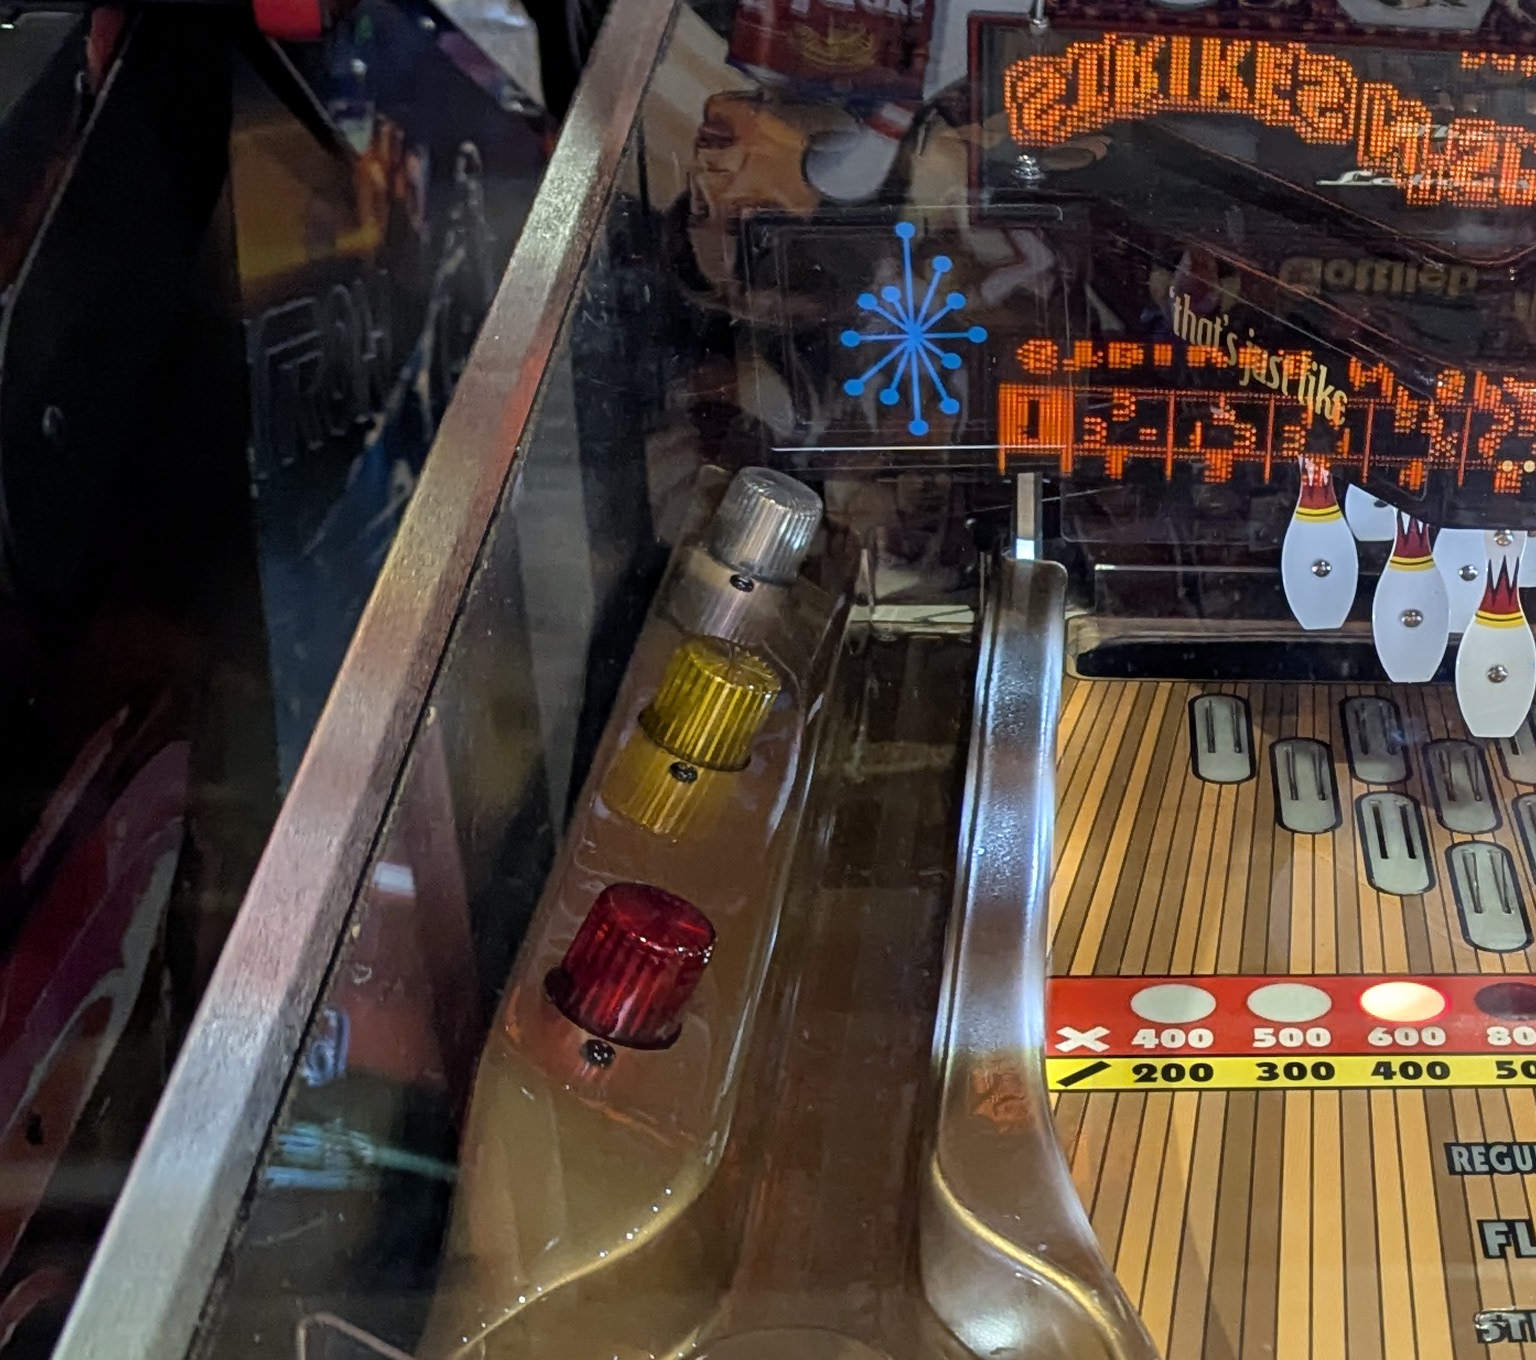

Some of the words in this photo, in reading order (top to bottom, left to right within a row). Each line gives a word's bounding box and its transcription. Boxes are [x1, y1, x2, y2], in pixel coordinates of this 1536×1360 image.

[1130, 1027, 1215, 1050] 400
[1252, 1027, 1333, 1049] 500
[1367, 1026, 1447, 1047] 600
[1131, 1062, 1215, 1083] 200
[1255, 1061, 1336, 1082] 300
[1370, 1060, 1451, 1081] 400
